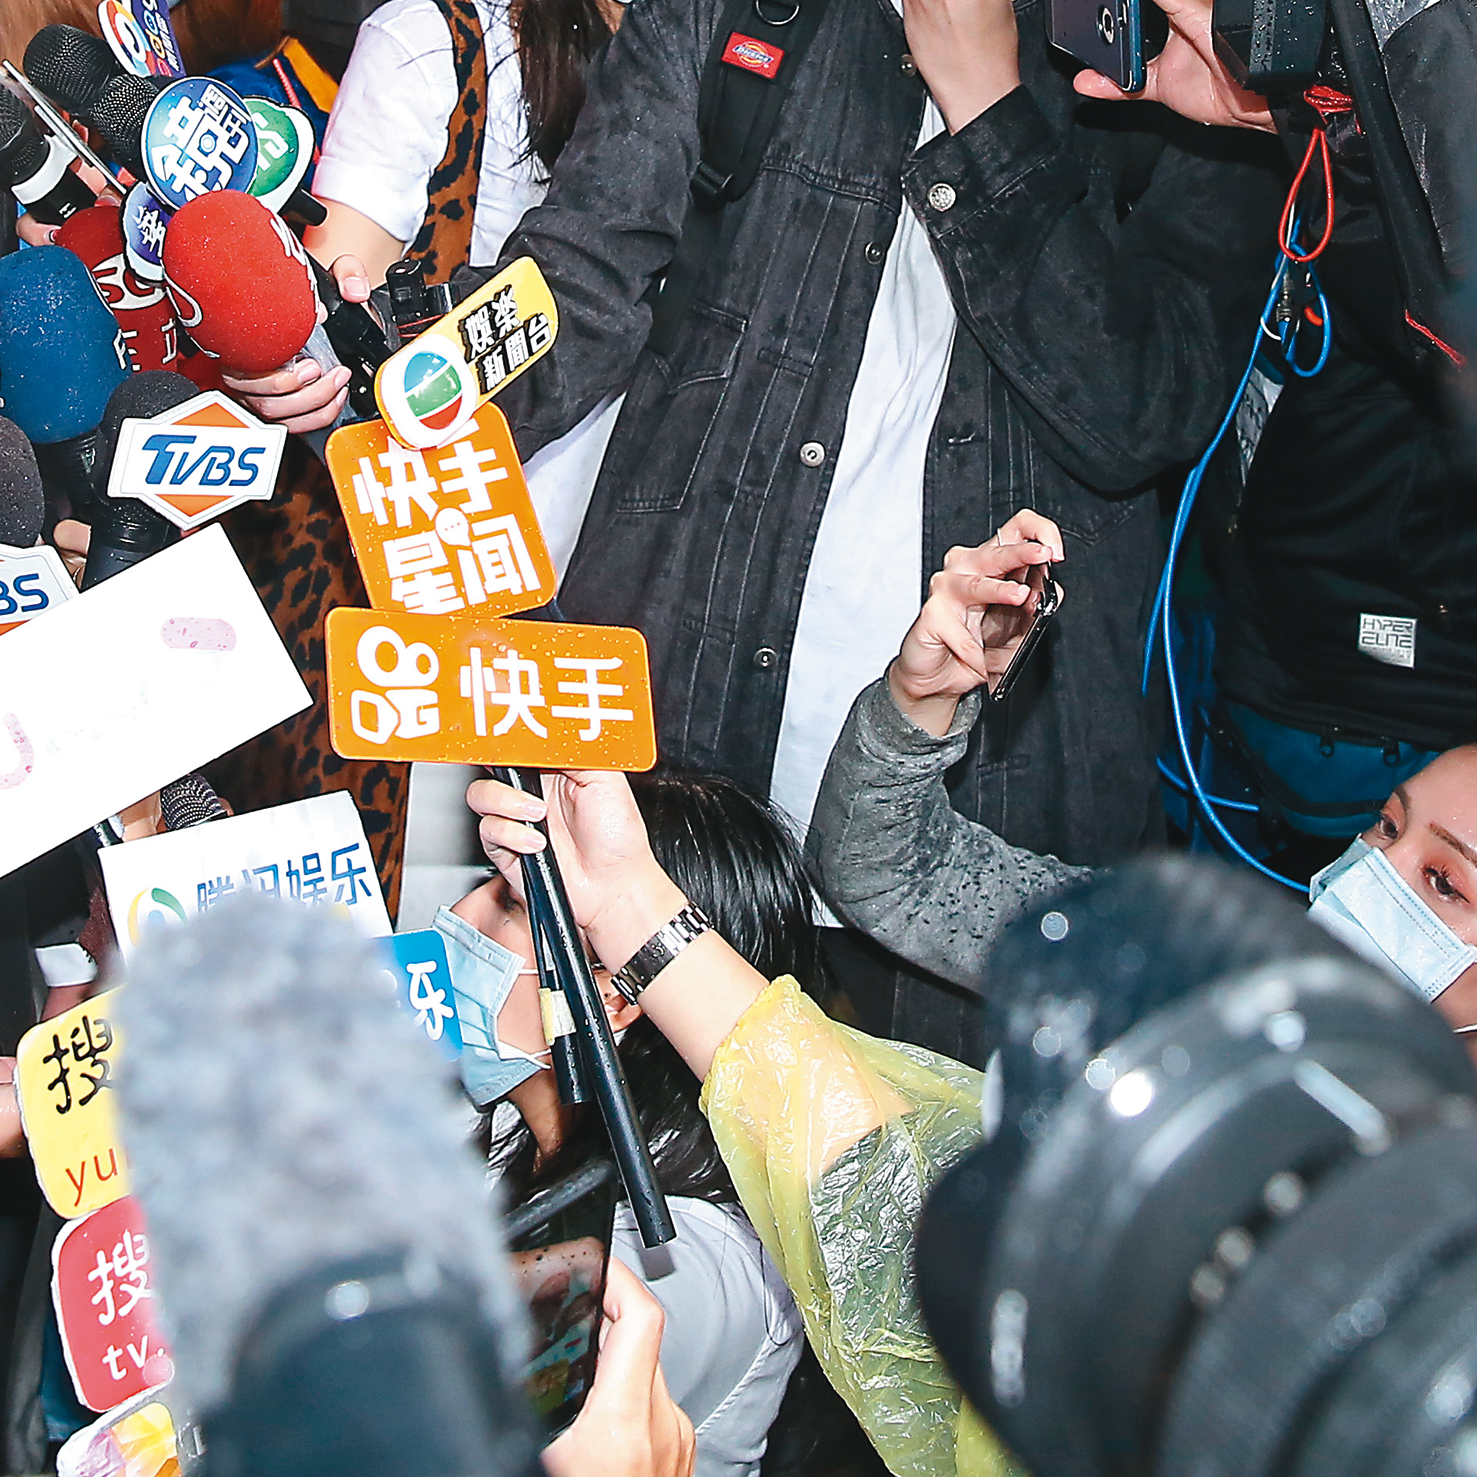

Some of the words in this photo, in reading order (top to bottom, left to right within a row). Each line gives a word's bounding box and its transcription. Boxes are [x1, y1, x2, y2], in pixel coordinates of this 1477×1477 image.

[141, 433, 267, 488] TVBS
[353, 418, 509, 527] 快手
[383, 511, 542, 615] 星闻
[1362, 617, 1414, 634] HYPER
[459, 644, 635, 742] 快手
[384, 959, 455, 1041] 乐
[65, 1147, 129, 1205] yu
